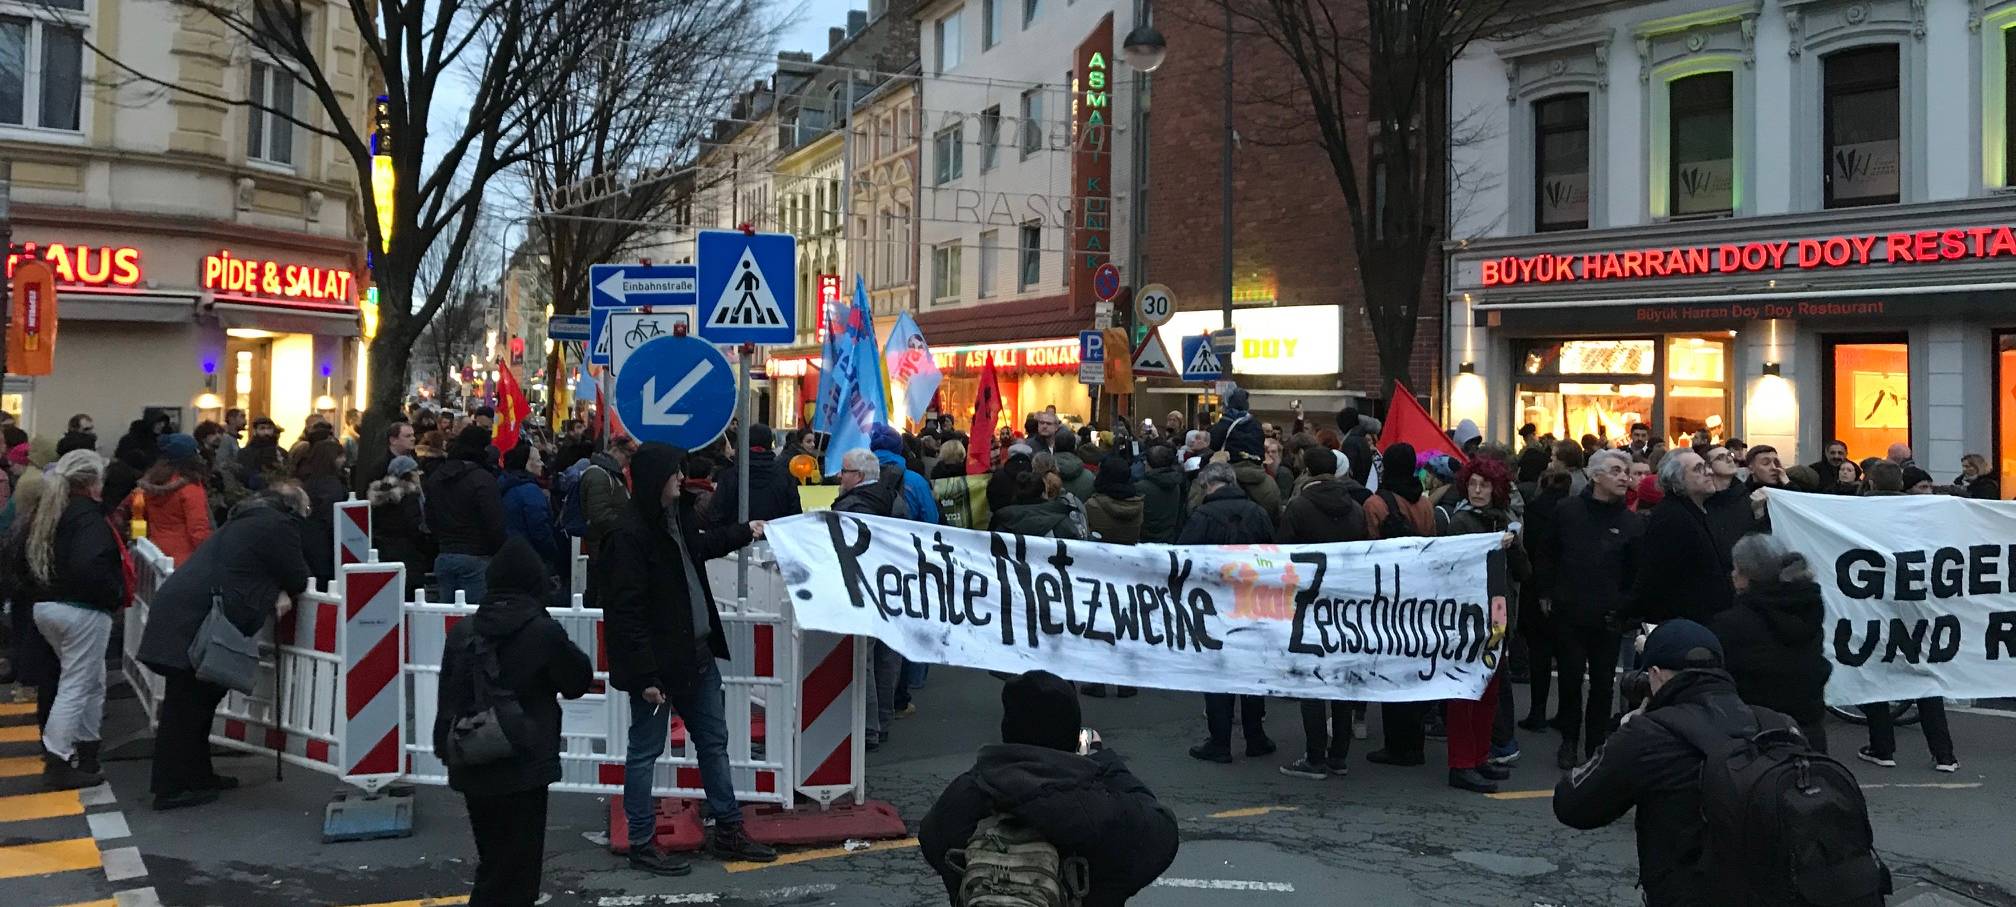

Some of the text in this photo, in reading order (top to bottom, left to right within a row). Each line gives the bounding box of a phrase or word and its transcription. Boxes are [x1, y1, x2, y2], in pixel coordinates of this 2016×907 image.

[1481, 224, 2016, 286] BÜYÜK HARRAN DOY DOY RESTA
[262, 261, 282, 296] &
[284, 265, 351, 302] SALAT
[622, 281, 693, 292] Einbahnstraße
[1144, 296, 1168, 316] 30
[1636, 301, 1884, 321] Büyük Harran Doy Doy Restaurant
[1087, 335, 1103, 358] P
[1242, 338, 1298, 359] DOY
[825, 510, 992, 623] Rechte
[1253, 553, 1274, 568] im
[1833, 614, 1961, 667] UND
